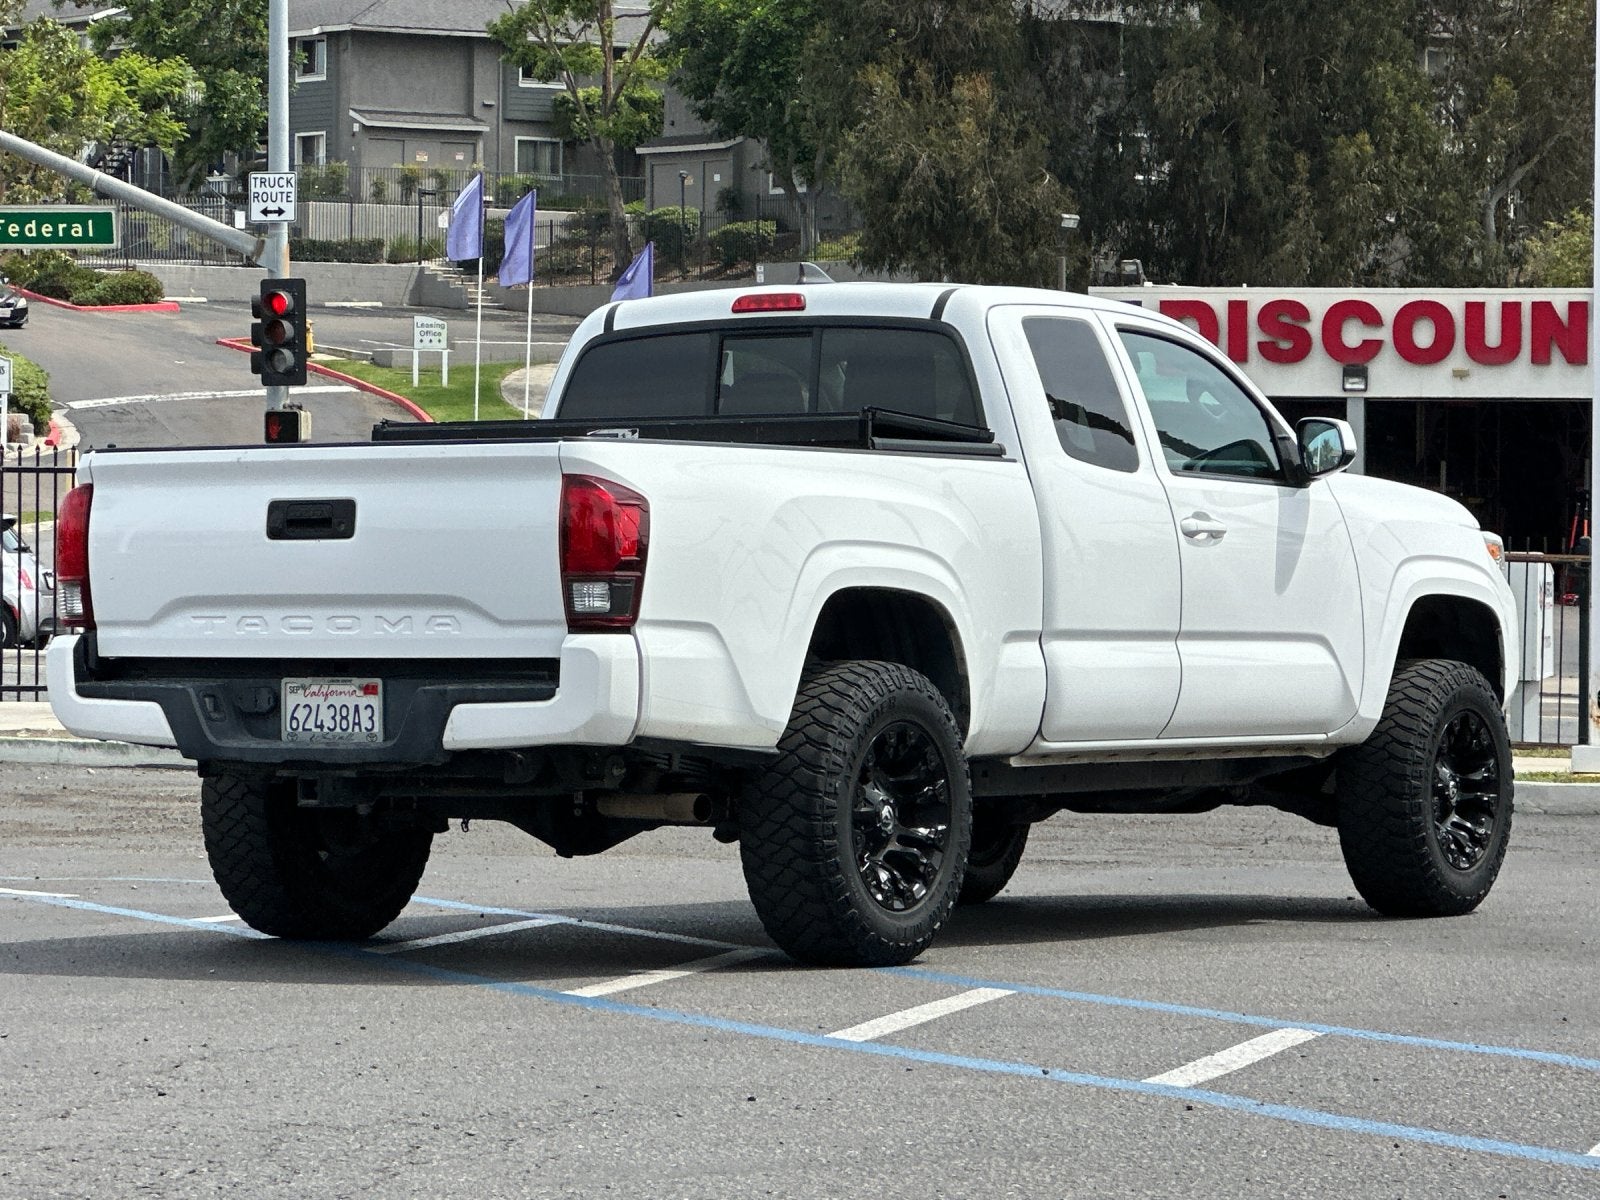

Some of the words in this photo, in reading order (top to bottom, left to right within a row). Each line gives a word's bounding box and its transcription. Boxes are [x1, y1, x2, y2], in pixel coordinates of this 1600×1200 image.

[252, 176, 294, 189] TRUCK
[252, 191, 293, 203] ROUTE
[416, 321, 446, 330] Leasing
[190, 614, 462, 636] TACOMA
[288, 685, 300, 694] SEP
[303, 684, 358, 702] California
[289, 703, 375, 733] 62438A3
